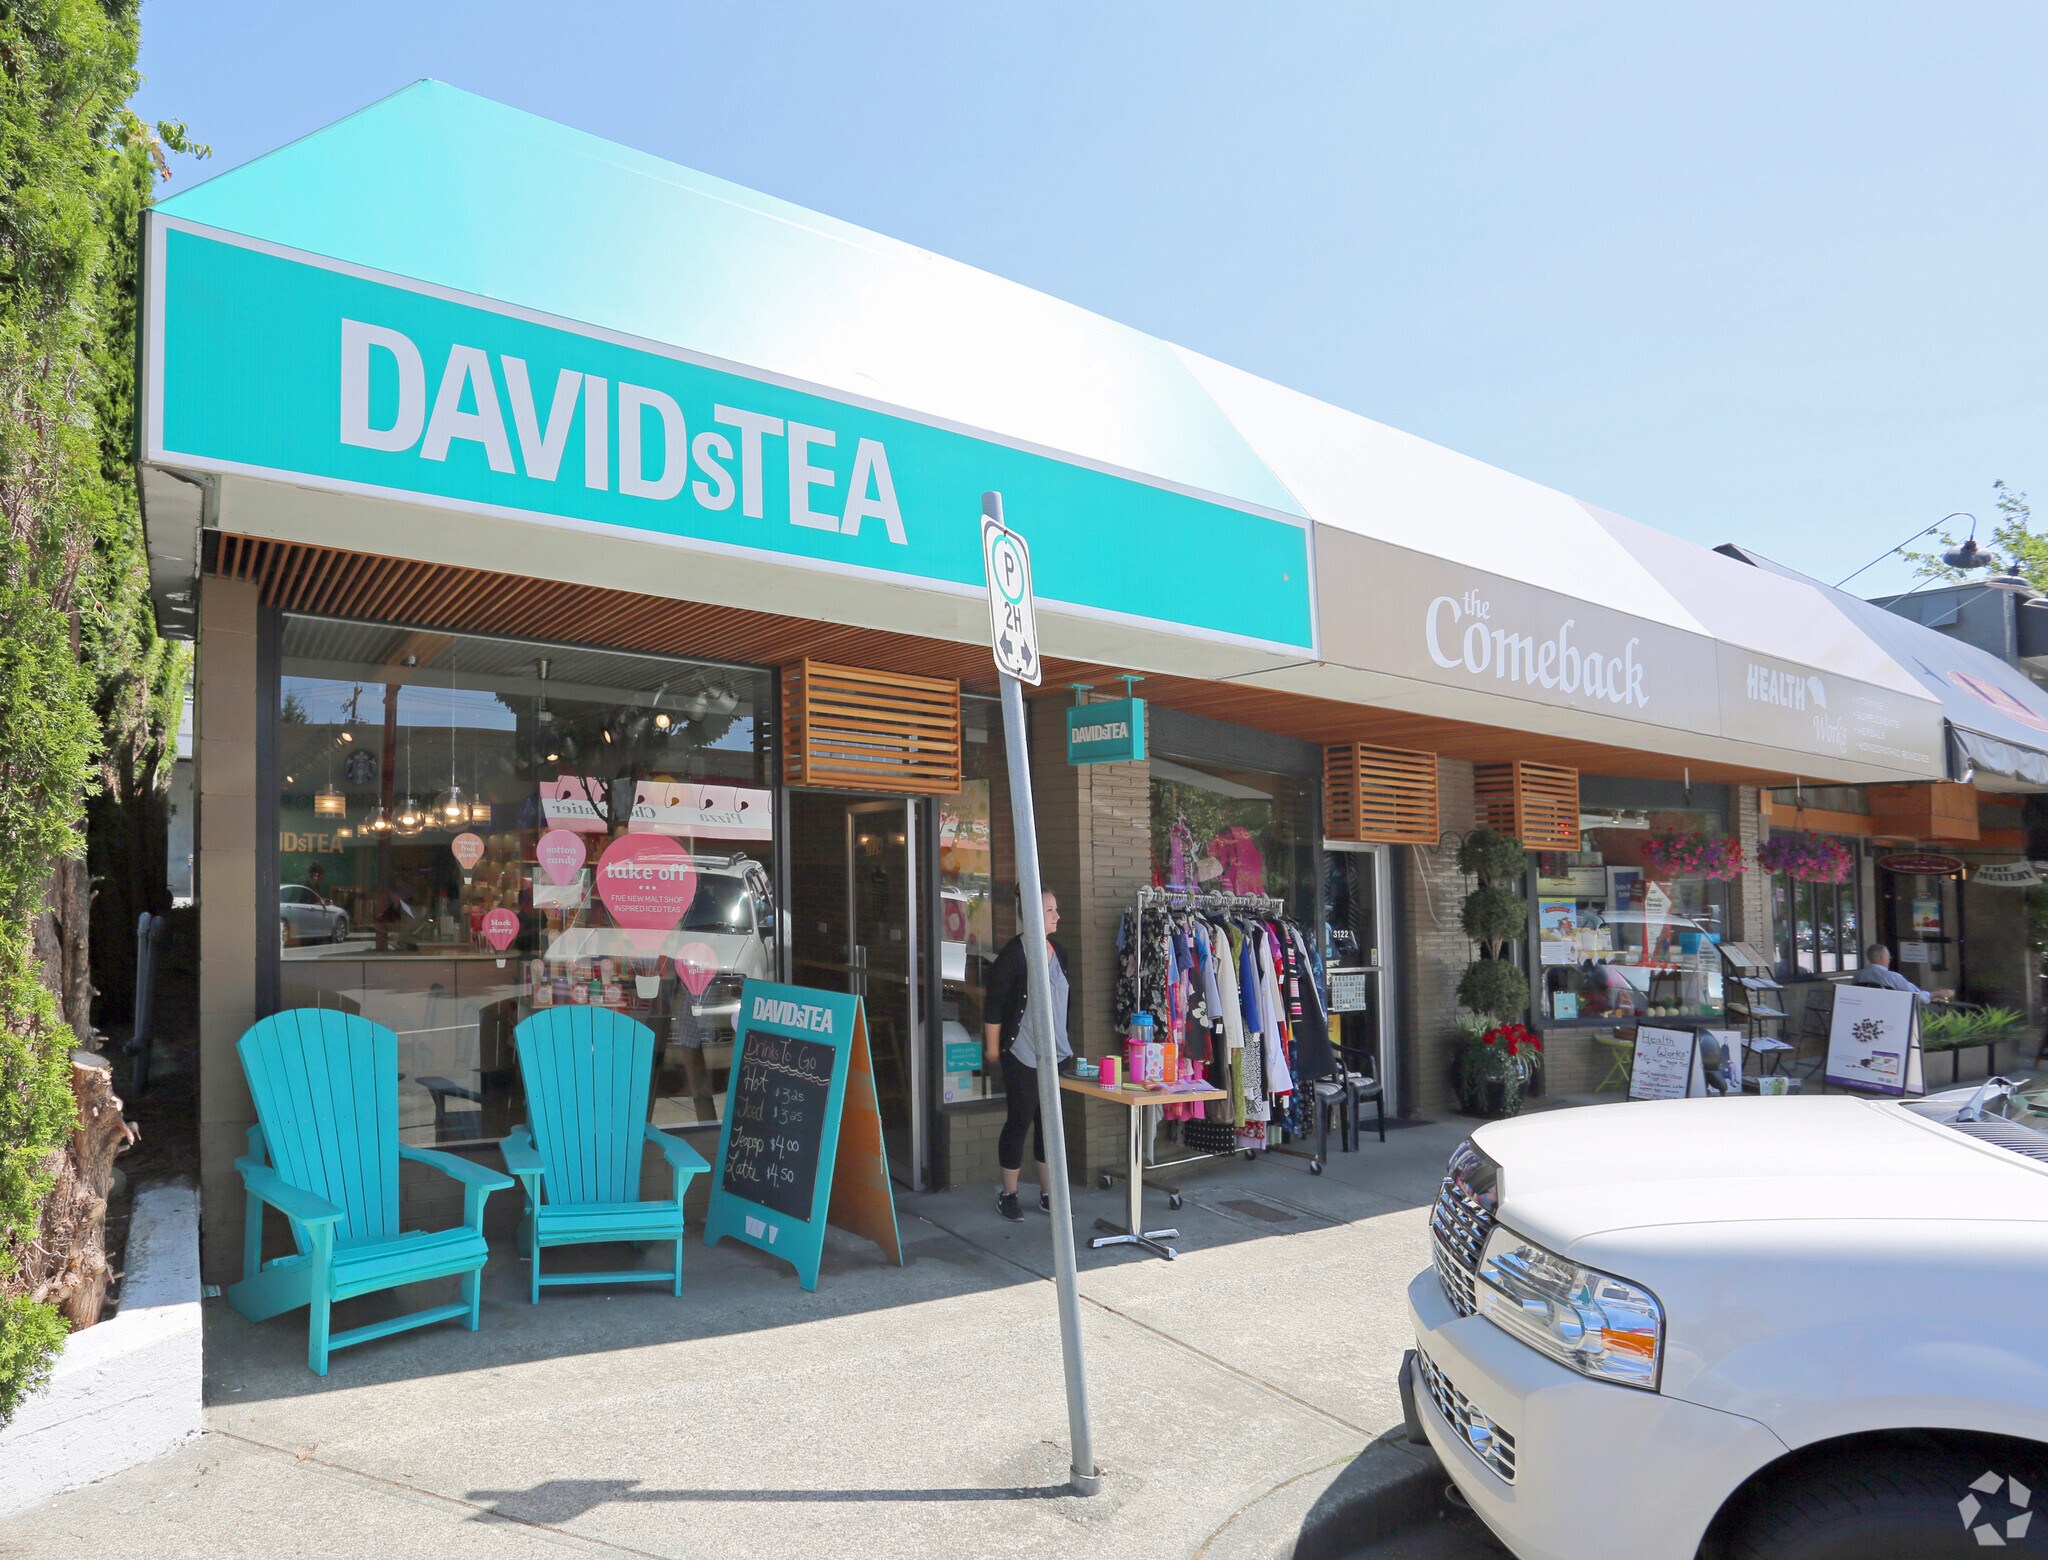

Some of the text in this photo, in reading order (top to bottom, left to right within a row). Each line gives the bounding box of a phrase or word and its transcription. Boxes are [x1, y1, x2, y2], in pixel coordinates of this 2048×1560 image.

[340, 318, 908, 546] DAVIDsTEA
[1004, 552, 1014, 586] P
[1462, 588, 1491, 620] the
[1004, 602, 1021, 634] 2H
[1426, 596, 1649, 708] Comeback
[1747, 663, 1805, 711] HEALTH
[1812, 713, 1847, 754] Works
[546, 846, 577, 854] cotton
[546, 856, 577, 865] candy
[605, 861, 688, 881] take off
[1978, 870, 2033, 882] MEATERY
[1984, 865, 2012, 873] THE
[611, 894, 626, 902] FIVE
[627, 895, 644, 903] NEW
[645, 895, 663, 903] MALT
[614, 904, 681, 913] INSPIRED ICED TEAS
[489, 927, 513, 935] cherry
[1333, 930, 1349, 938] 3122
[1642, 1029, 1675, 1046] Health
[779, 1041, 792, 1064] To
[798, 1046, 816, 1071] Go
[743, 1066, 768, 1092] Hot
[725, 1150, 760, 1181] Latte
